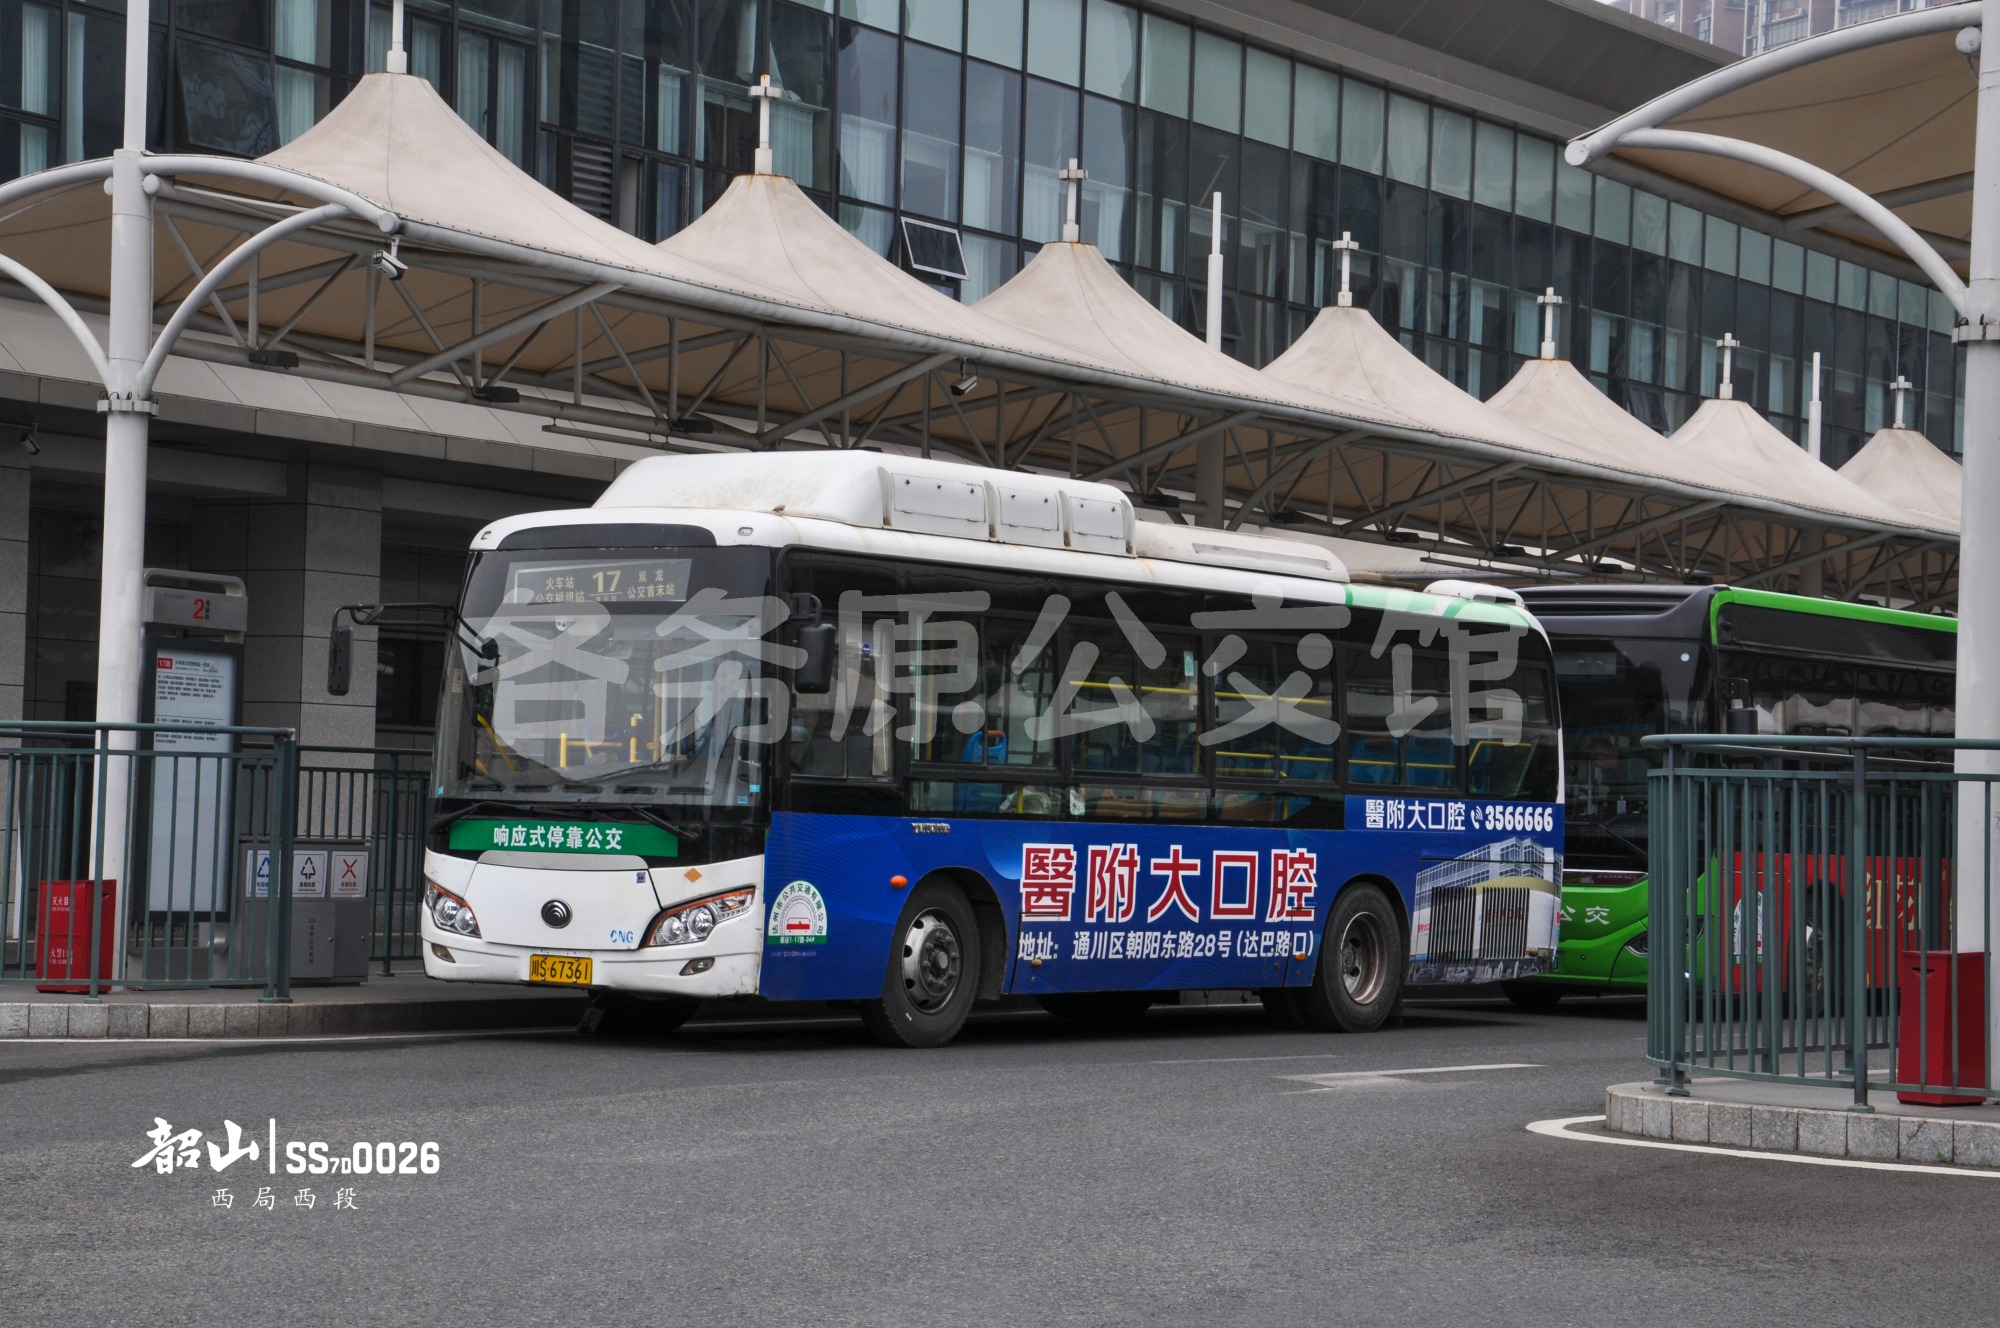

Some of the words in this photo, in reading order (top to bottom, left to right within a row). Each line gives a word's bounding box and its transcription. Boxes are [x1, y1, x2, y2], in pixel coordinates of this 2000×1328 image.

[545, 576, 575, 590] 火车站
[592, 570, 621, 593] 17
[638, 571, 647, 582] 双
[654, 569, 664, 581] 龙
[627, 584, 675, 599] 公交首末站
[192, 597, 206, 620] 2
[1485, 805, 1554, 832] 3566666
[493, 824, 623, 850] 响应式停靠公交
[610, 929, 634, 943] CNG
